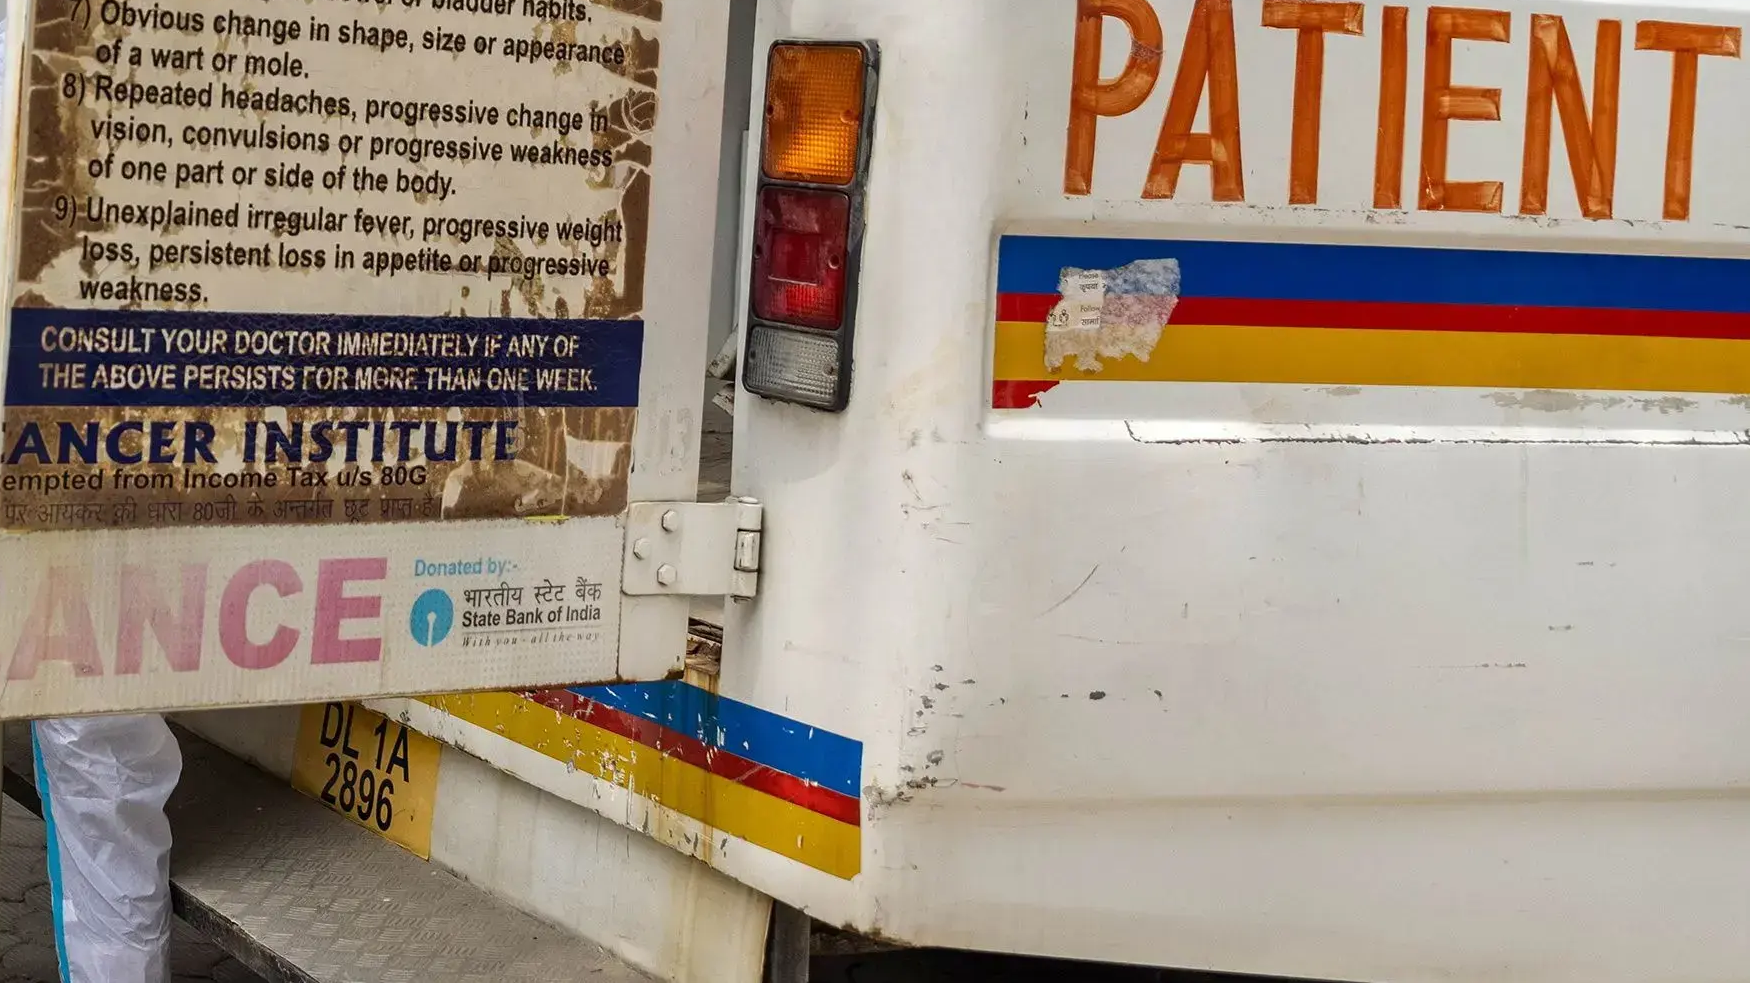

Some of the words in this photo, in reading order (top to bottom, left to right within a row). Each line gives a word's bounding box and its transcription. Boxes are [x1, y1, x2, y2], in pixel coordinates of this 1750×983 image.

[95, 39, 123, 65] of
[150, 47, 204, 71] wart
[211, 51, 238, 73] or
[244, 51, 310, 79] mole.
[212, 9, 301, 45] change
[309, 16, 330, 42] in
[337, 19, 415, 53] shape,
[421, 26, 467, 52] size
[473, 34, 498, 55] or
[502, 36, 626, 66] appearance
[62, 72, 86, 106] 8)
[94, 73, 213, 110] Repeated
[221, 82, 357, 122] headaches,
[365, 97, 500, 127] progressive
[506, 102, 584, 136] change
[90, 115, 174, 149] vision,
[182, 119, 330, 152] convulsions
[337, 132, 364, 154] or
[369, 135, 503, 164] progressive
[510, 139, 613, 167] weakness
[88, 152, 115, 180] of
[120, 159, 168, 182] one
[175, 162, 225, 188] part
[231, 166, 259, 187] or
[264, 161, 314, 188] side
[321, 164, 347, 190] of
[352, 166, 388, 192] the
[396, 167, 457, 200] body.
[53, 194, 78, 228] 9)
[86, 196, 240, 231] Unexplained
[246, 203, 348, 236] irregular
[353, 207, 415, 238] fever,
[422, 214, 550, 244] progressive
[556, 216, 623, 247] weight
[81, 235, 141, 267] loss,
[149, 239, 271, 270] persistent
[277, 242, 326, 268] loss
[334, 244, 355, 269] in
[362, 247, 452, 276] appetite
[458, 253, 481, 274] or
[486, 252, 611, 281] progressive
[79, 275, 209, 303] weakness.
[40, 326, 152, 354] CONSULT
[160, 328, 228, 355] YOUR
[234, 330, 331, 356] DOCTOR
[337, 331, 480, 358] IMMEDIATELY
[506, 334, 550, 358] ANY
[553, 334, 580, 358] OF
[38, 362, 87, 389] THE
[92, 363, 176, 390] ABOVE
[183, 364, 295, 391] PERSISTS
[302, 366, 349, 391] FOR
[354, 367, 418, 391] MORE
[425, 368, 481, 391] THAN
[486, 368, 530, 392] ONE
[1, 421, 219, 465] ANCER
[243, 420, 519, 463] INSTITUTE
[0, 469, 103, 497] empted
[113, 469, 174, 490] from
[183, 468, 278, 490] Income
[286, 466, 328, 488] Tax
[337, 466, 372, 487] u/s
[380, 465, 428, 487] 80G
[414, 558, 483, 577] Donated
[463, 581, 524, 608] भारतीय
[533, 578, 567, 604] स्टेट
[575, 576, 603, 602] बैंक
[461, 610, 501, 628] State
[505, 608, 544, 625] Bank
[548, 606, 562, 623] of
[565, 604, 601, 622] India
[320, 701, 360, 760] DL
[373, 718, 410, 783] 1A
[320, 752, 394, 832] 2896
